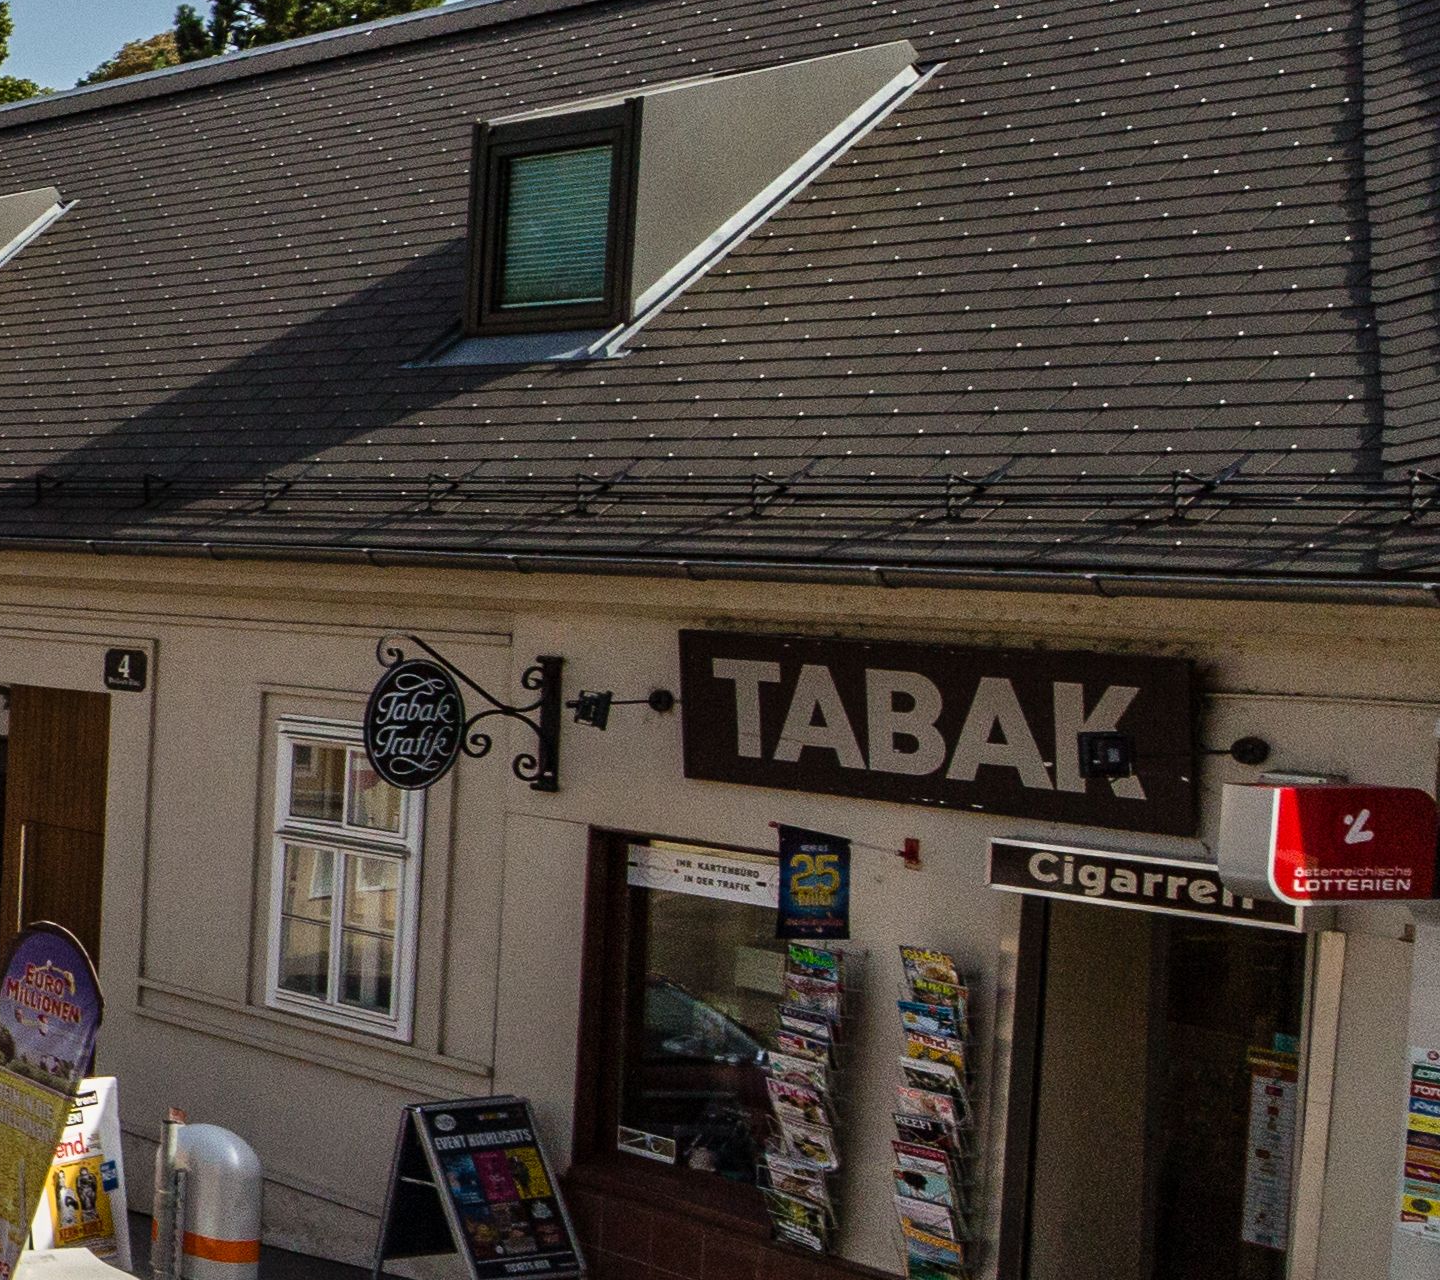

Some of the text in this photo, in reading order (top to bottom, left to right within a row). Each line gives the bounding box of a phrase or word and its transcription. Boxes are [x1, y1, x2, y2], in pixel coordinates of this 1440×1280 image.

[118, 654, 130, 678] 4
[376, 690, 456, 724] Tabak
[374, 724, 454, 761] Trafik
[711, 657, 1147, 801] TABAK
[675, 858, 760, 879] IHR KARTENBÜRO
[683, 874, 751, 892] IN DER TRAFIK
[789, 853, 841, 894] 25
[1293, 877, 1412, 893] LOTTERIEN
[25, 962, 64, 998] EURO
[434, 1128, 533, 1151] EVENT HIGHLIGHTS
